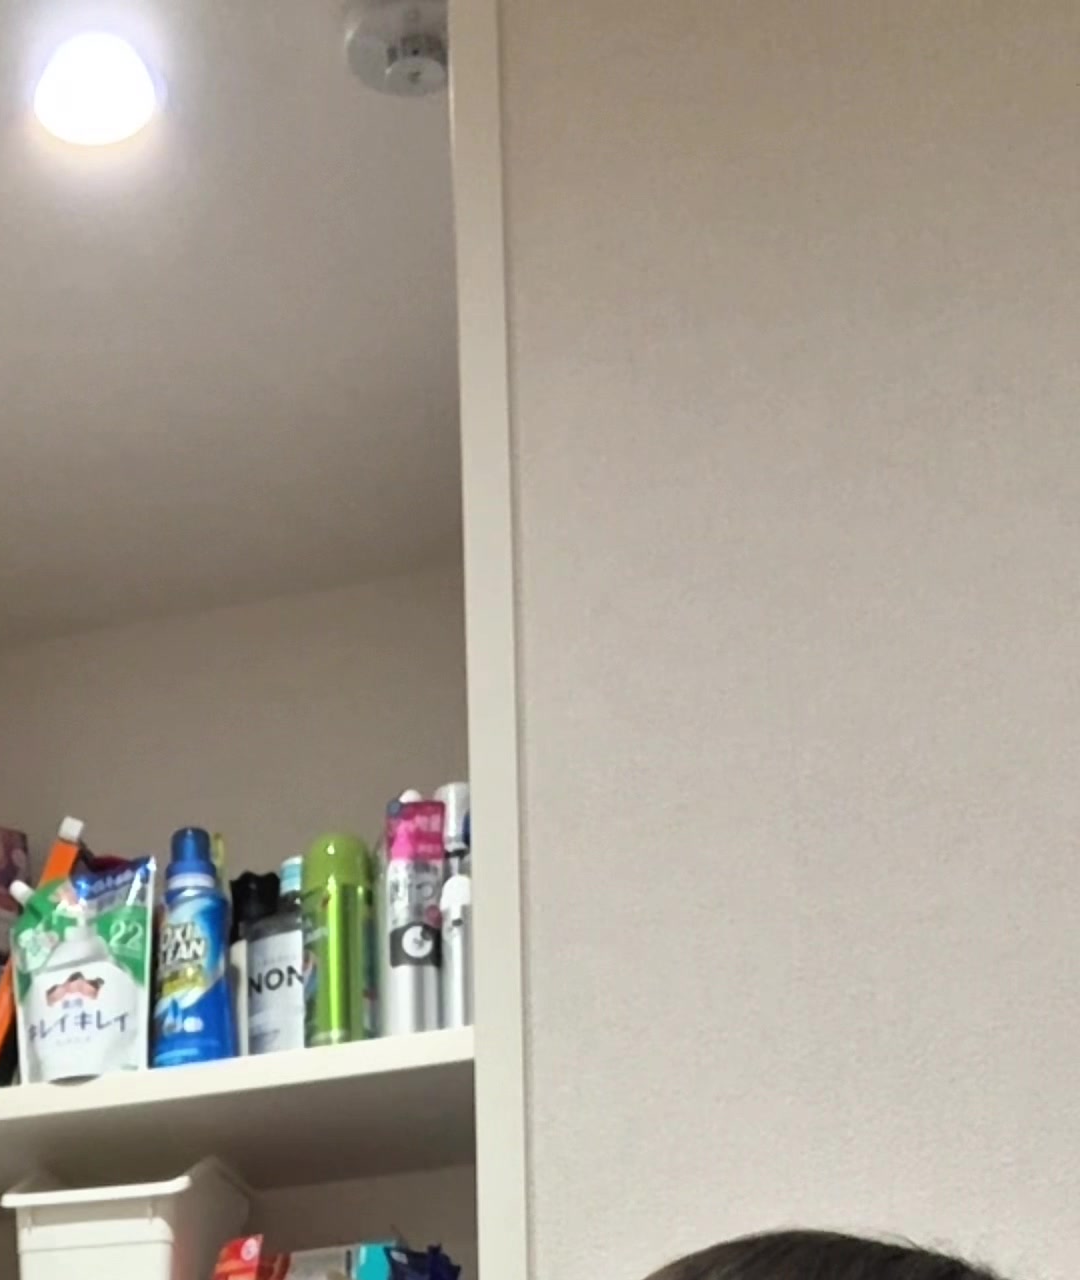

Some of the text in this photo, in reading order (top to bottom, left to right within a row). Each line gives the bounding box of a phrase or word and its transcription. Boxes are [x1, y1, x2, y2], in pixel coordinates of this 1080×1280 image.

[29, 1009, 129, 1041] キレイキレイ
